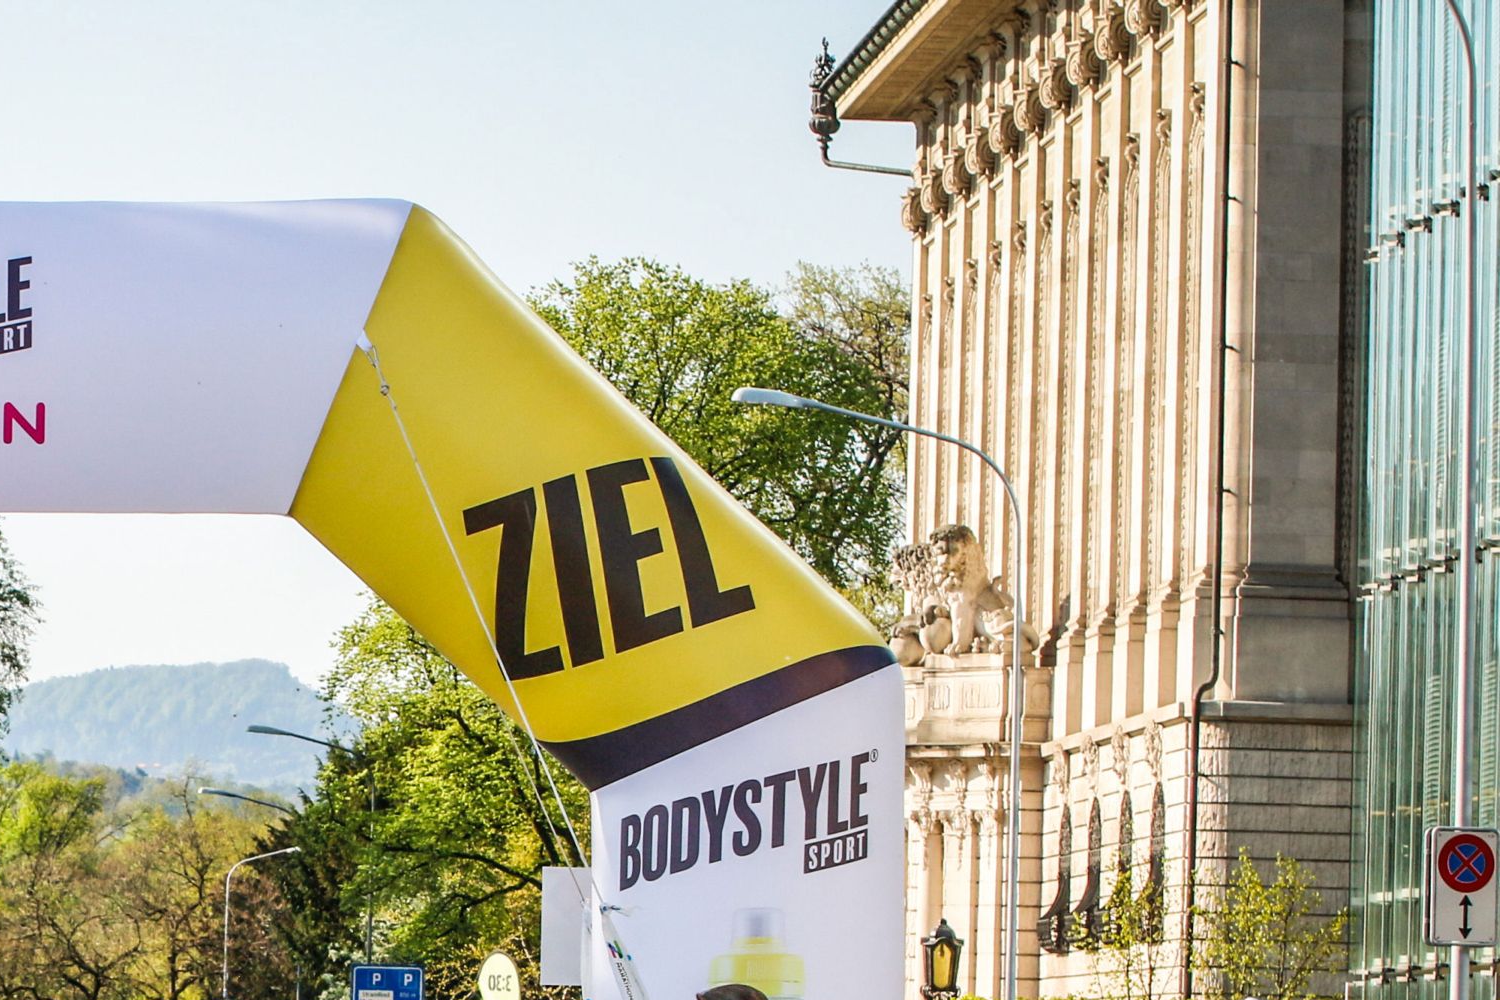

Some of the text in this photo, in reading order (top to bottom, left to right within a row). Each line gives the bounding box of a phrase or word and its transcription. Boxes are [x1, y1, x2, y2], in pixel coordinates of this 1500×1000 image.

[462, 456, 756, 682] ZIEL
[806, 831, 867, 872] SPORT
[372, 972, 413, 987] P P
